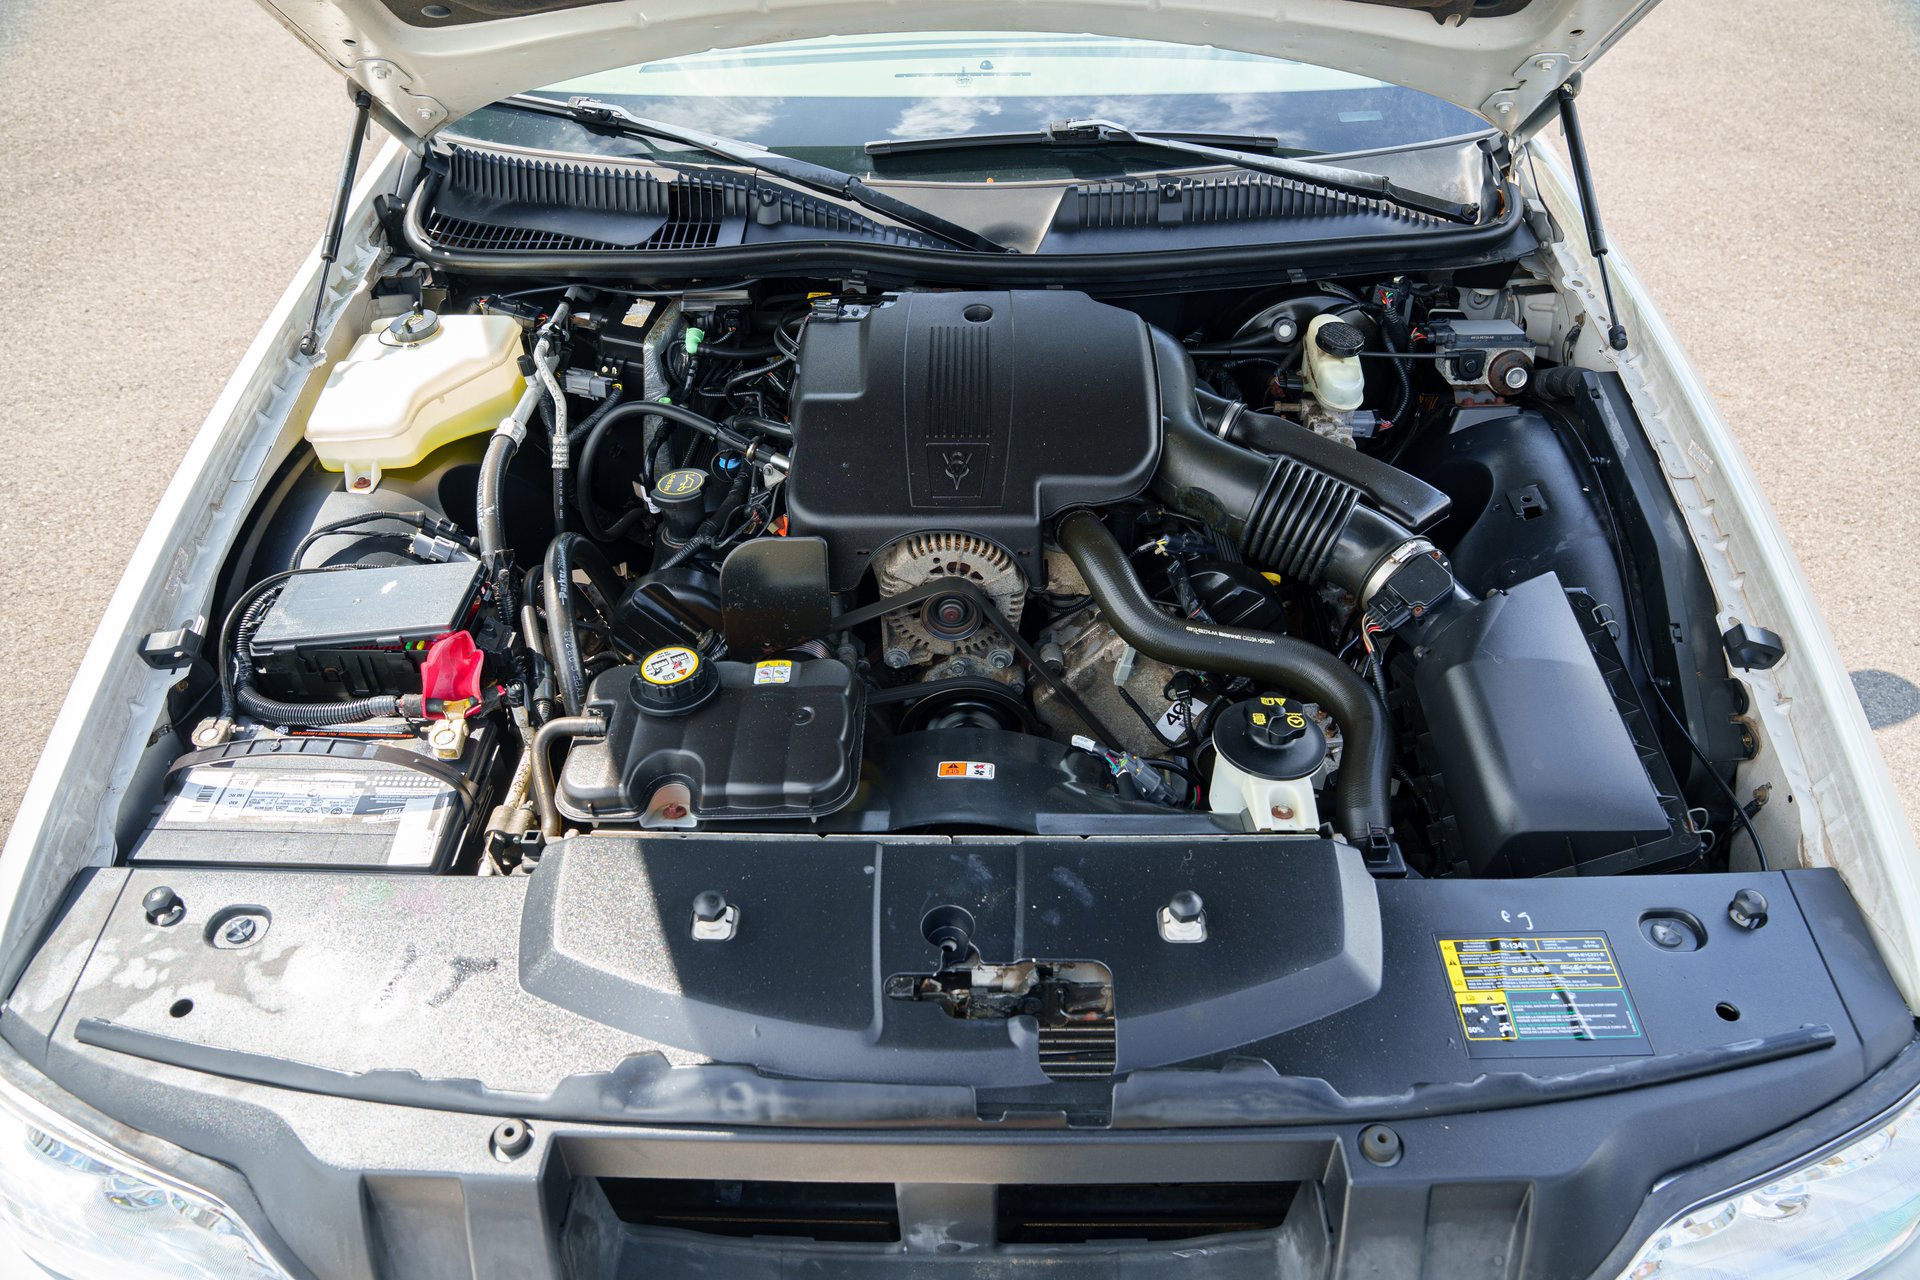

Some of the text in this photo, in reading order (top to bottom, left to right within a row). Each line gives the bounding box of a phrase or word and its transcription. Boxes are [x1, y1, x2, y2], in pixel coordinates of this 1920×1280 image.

[557, 566, 568, 597] Parker
[573, 674, 585, 700] TYPE
[1500, 941, 1529, 949] R-134A
